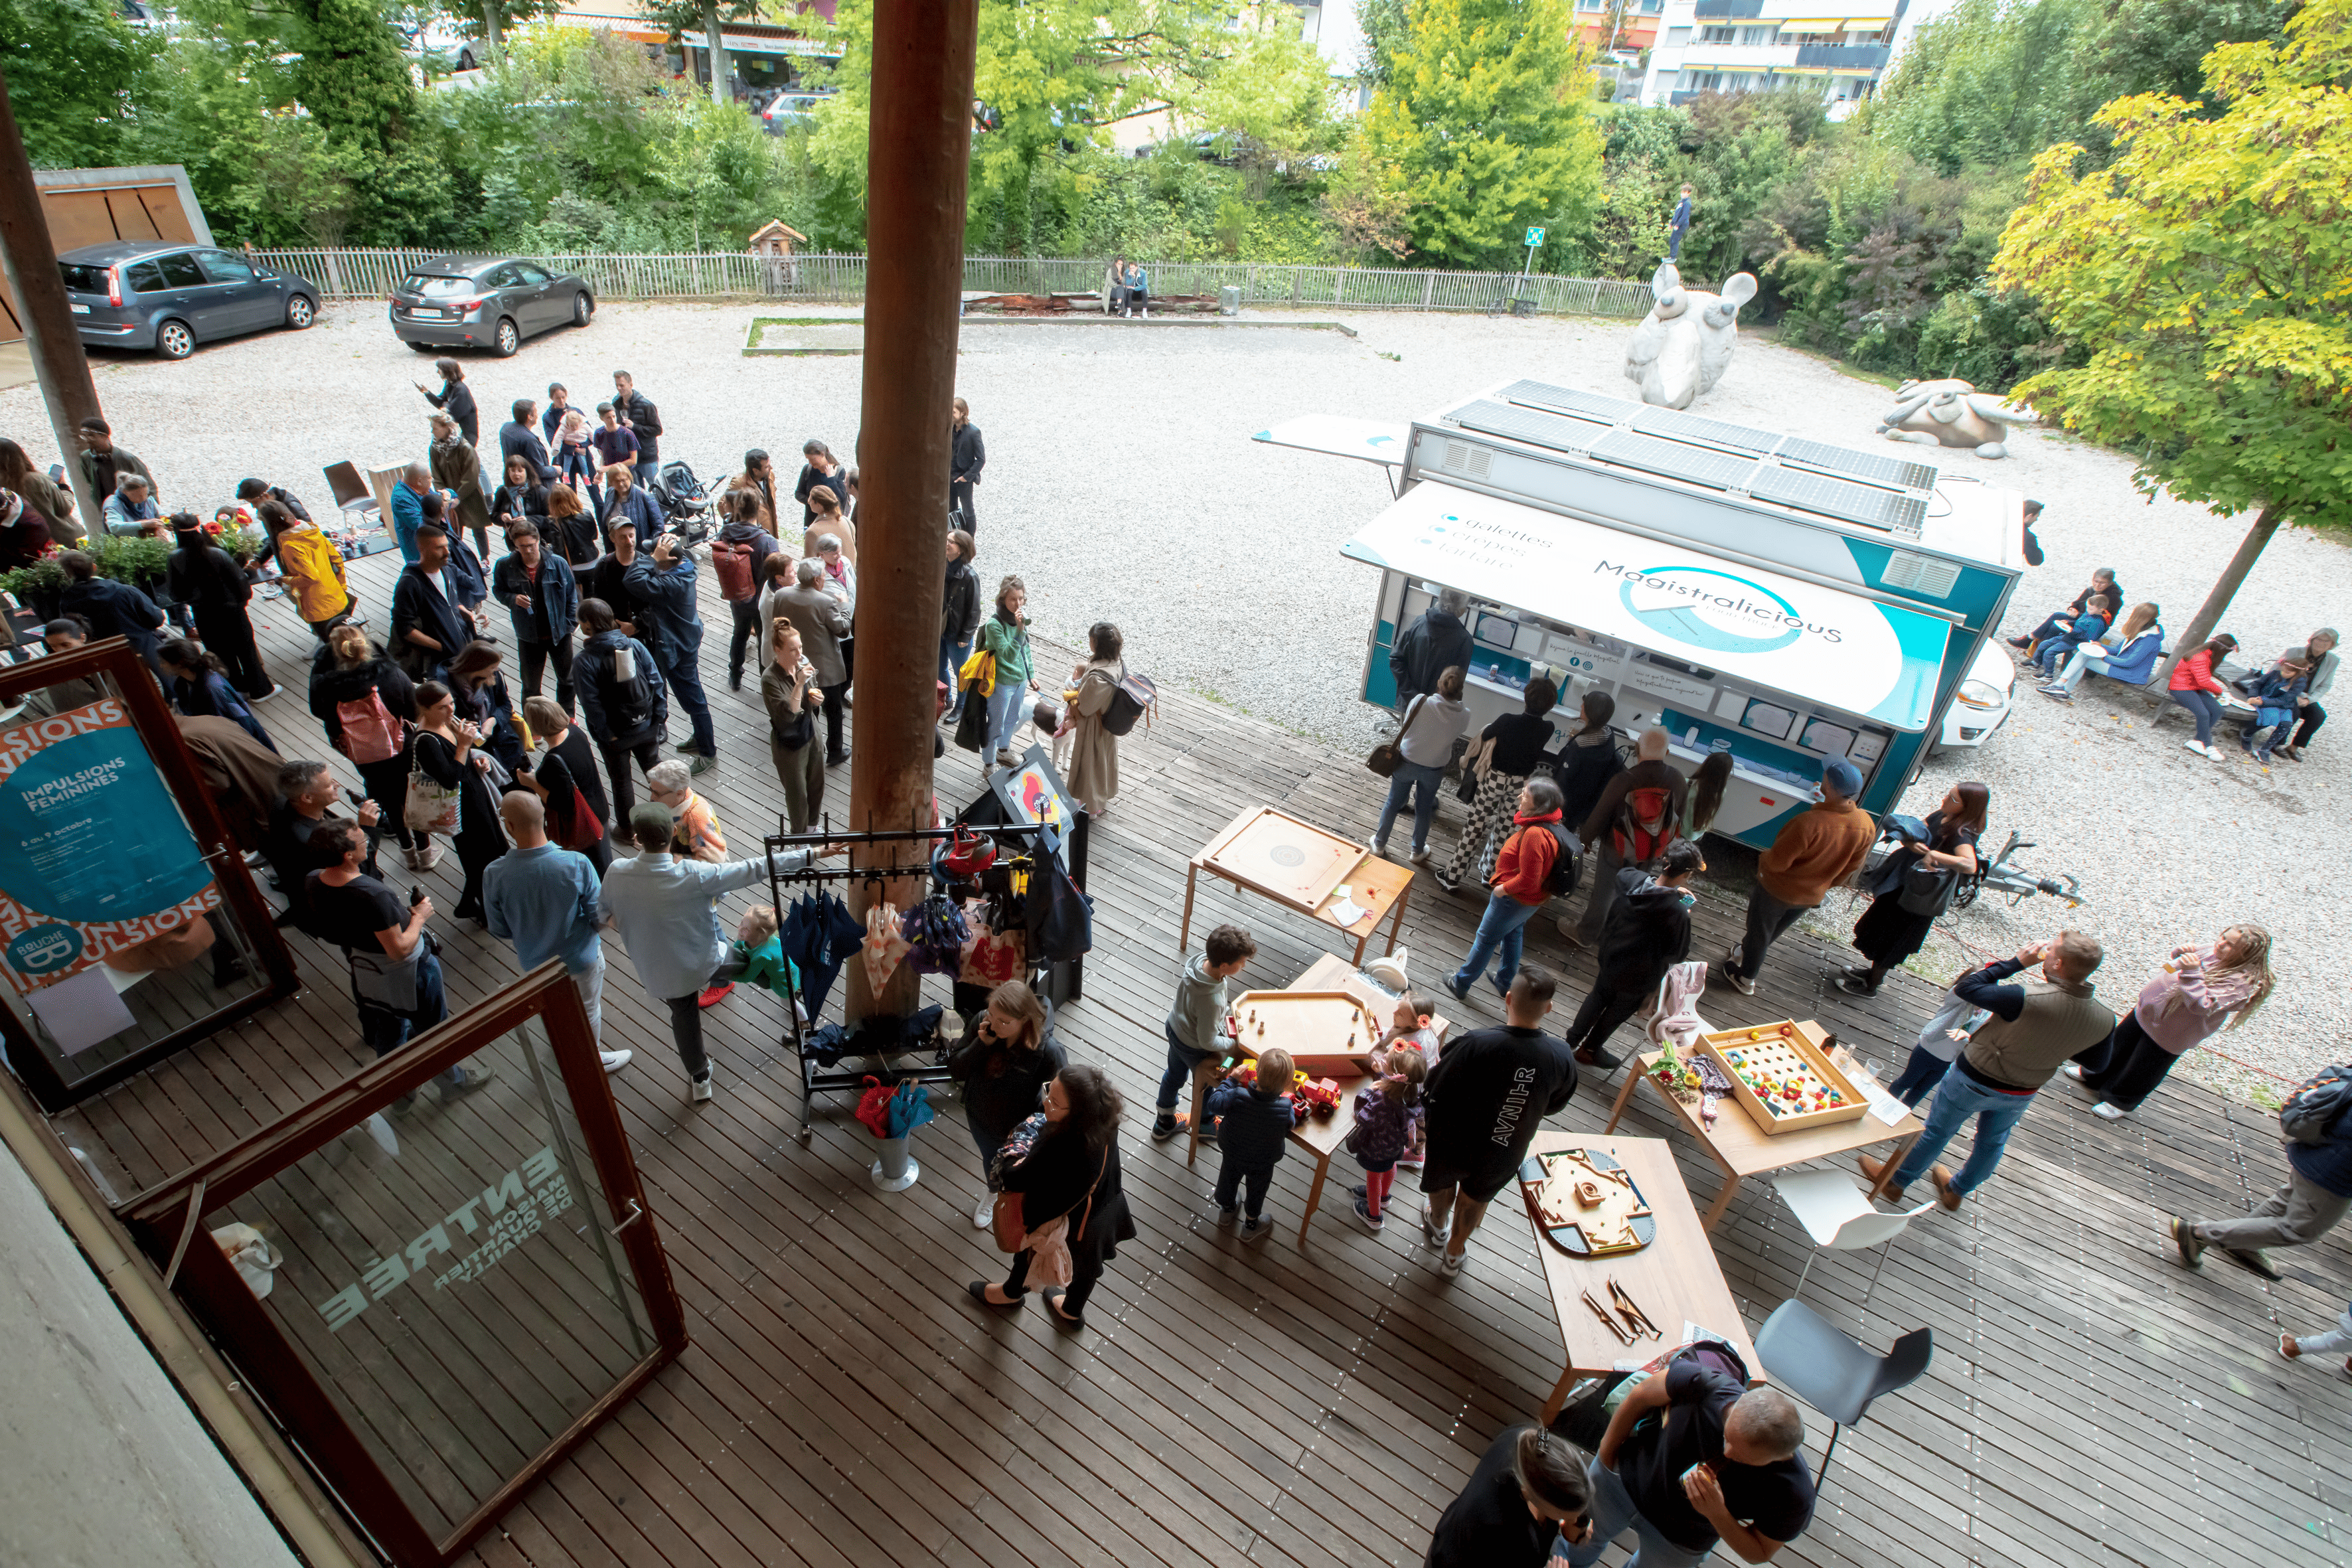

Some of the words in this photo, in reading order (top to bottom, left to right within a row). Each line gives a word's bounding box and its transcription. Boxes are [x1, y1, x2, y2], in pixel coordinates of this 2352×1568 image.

[1452, 532, 1526, 557] crêpes
[1464, 520, 1553, 548] galettes
[1439, 543, 1512, 570] tartare
[1594, 560, 1842, 643] Magistralicious
[21, 757, 126, 802] IMPULSIONS
[27, 771, 119, 811] FEMININES
[54, 818, 92, 835] octobre
[17, 930, 66, 956] BOUCHE
